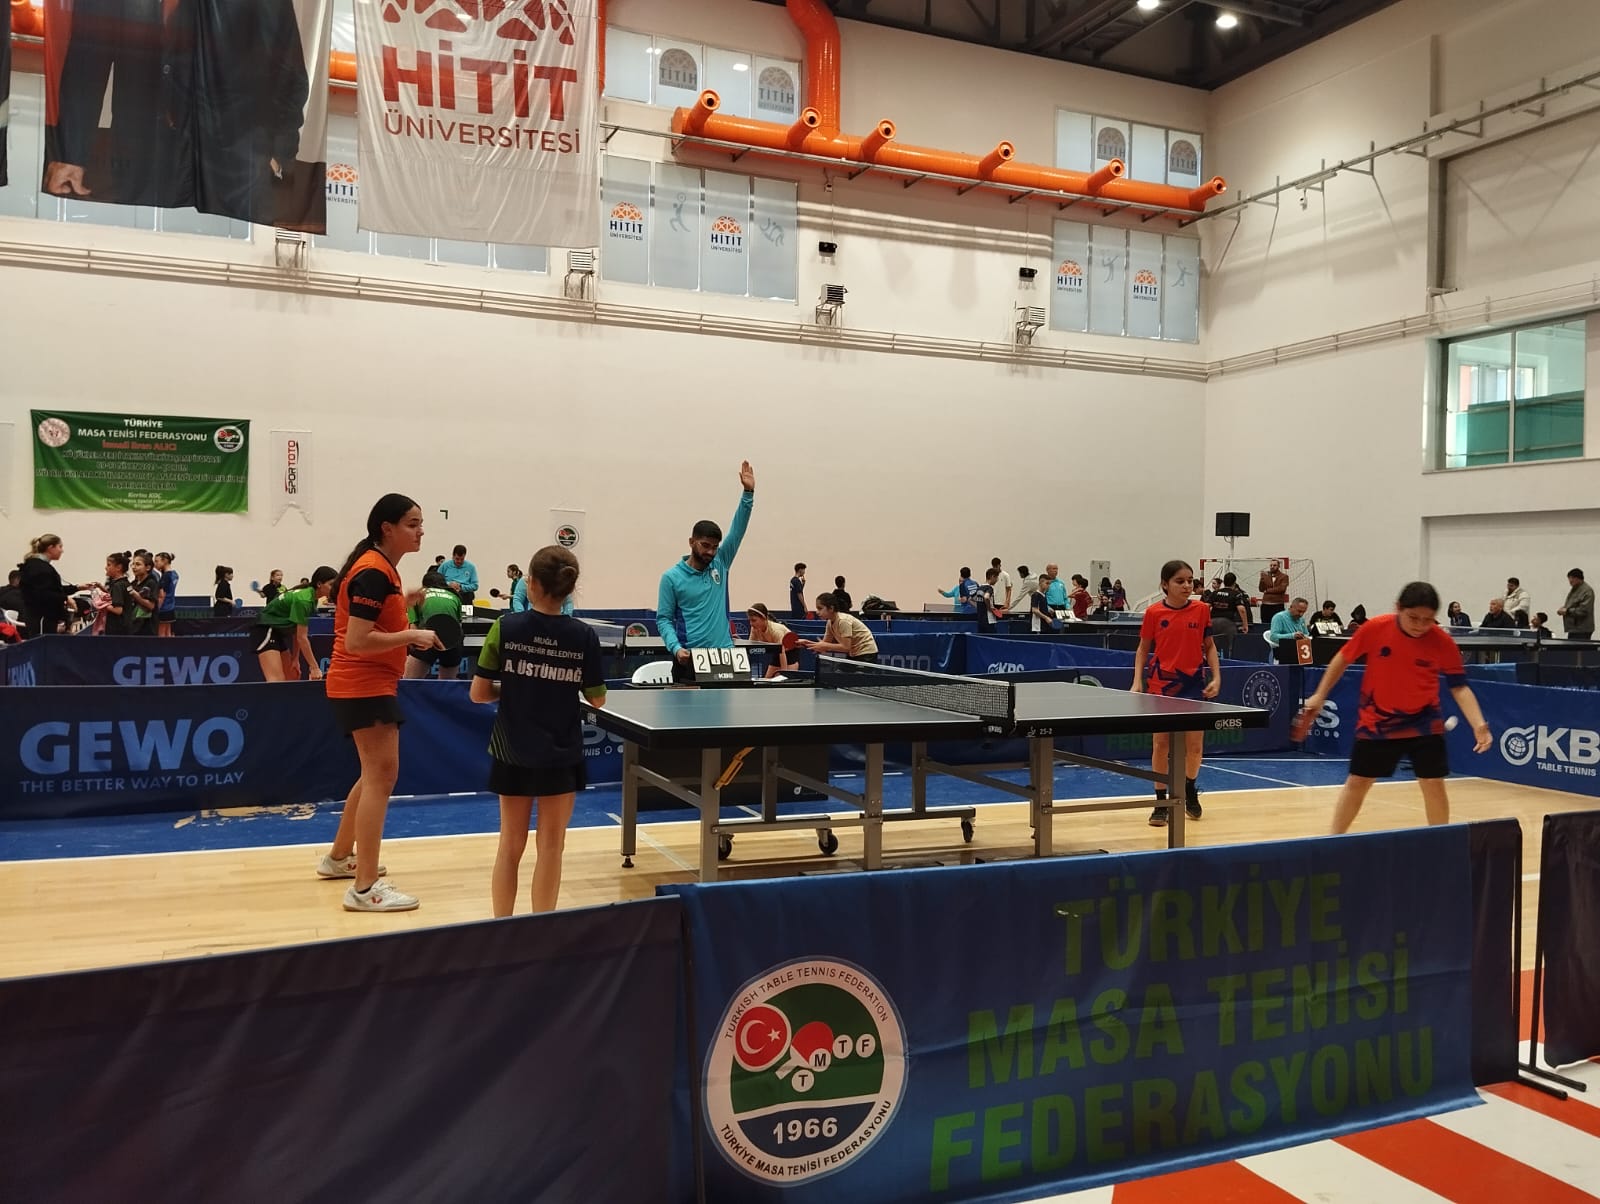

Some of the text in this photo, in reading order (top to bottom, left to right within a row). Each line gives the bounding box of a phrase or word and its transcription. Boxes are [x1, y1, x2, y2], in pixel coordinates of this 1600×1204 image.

[382, 39, 577, 122] HİTİT
[384, 109, 580, 153] ÜNİVERSİTESİ
[610, 220, 643, 234] HİTİT
[710, 232, 742, 247] HİTİT
[78, 428, 207, 441] MASA TENİSİ FEDERASYONU
[123, 418, 163, 428] TÜRKİYE
[504, 641, 546, 655] BÜYÜKŞEHİR
[533, 636, 558, 647] MUĞLA
[1301, 644, 1310, 659] 3
[113, 655, 240, 686] GEWO
[504, 659, 583, 683] A. ÜSTÜNDAĞ
[696, 651, 747, 671] 2 1 0 2
[1222, 718, 1243, 728] KBS
[19, 717, 245, 775] GEWO
[1536, 761, 1597, 777] TABLE TENNIS
[20, 771, 245, 793] THE BETTER WAY TO PLAY
[1053, 863, 1343, 977] TÜRKİYE
[725, 966, 889, 1040] TURKISH TABLE TENNIS FEDERATION
[967, 932, 1410, 1089] MASA TENİSİ
[930, 1026, 1435, 1193] FEDERASYONU
[719, 1100, 892, 1177] TÜRKİYE MASA TENİSİ FEDERASYONU
[773, 1117, 838, 1145] 1966
